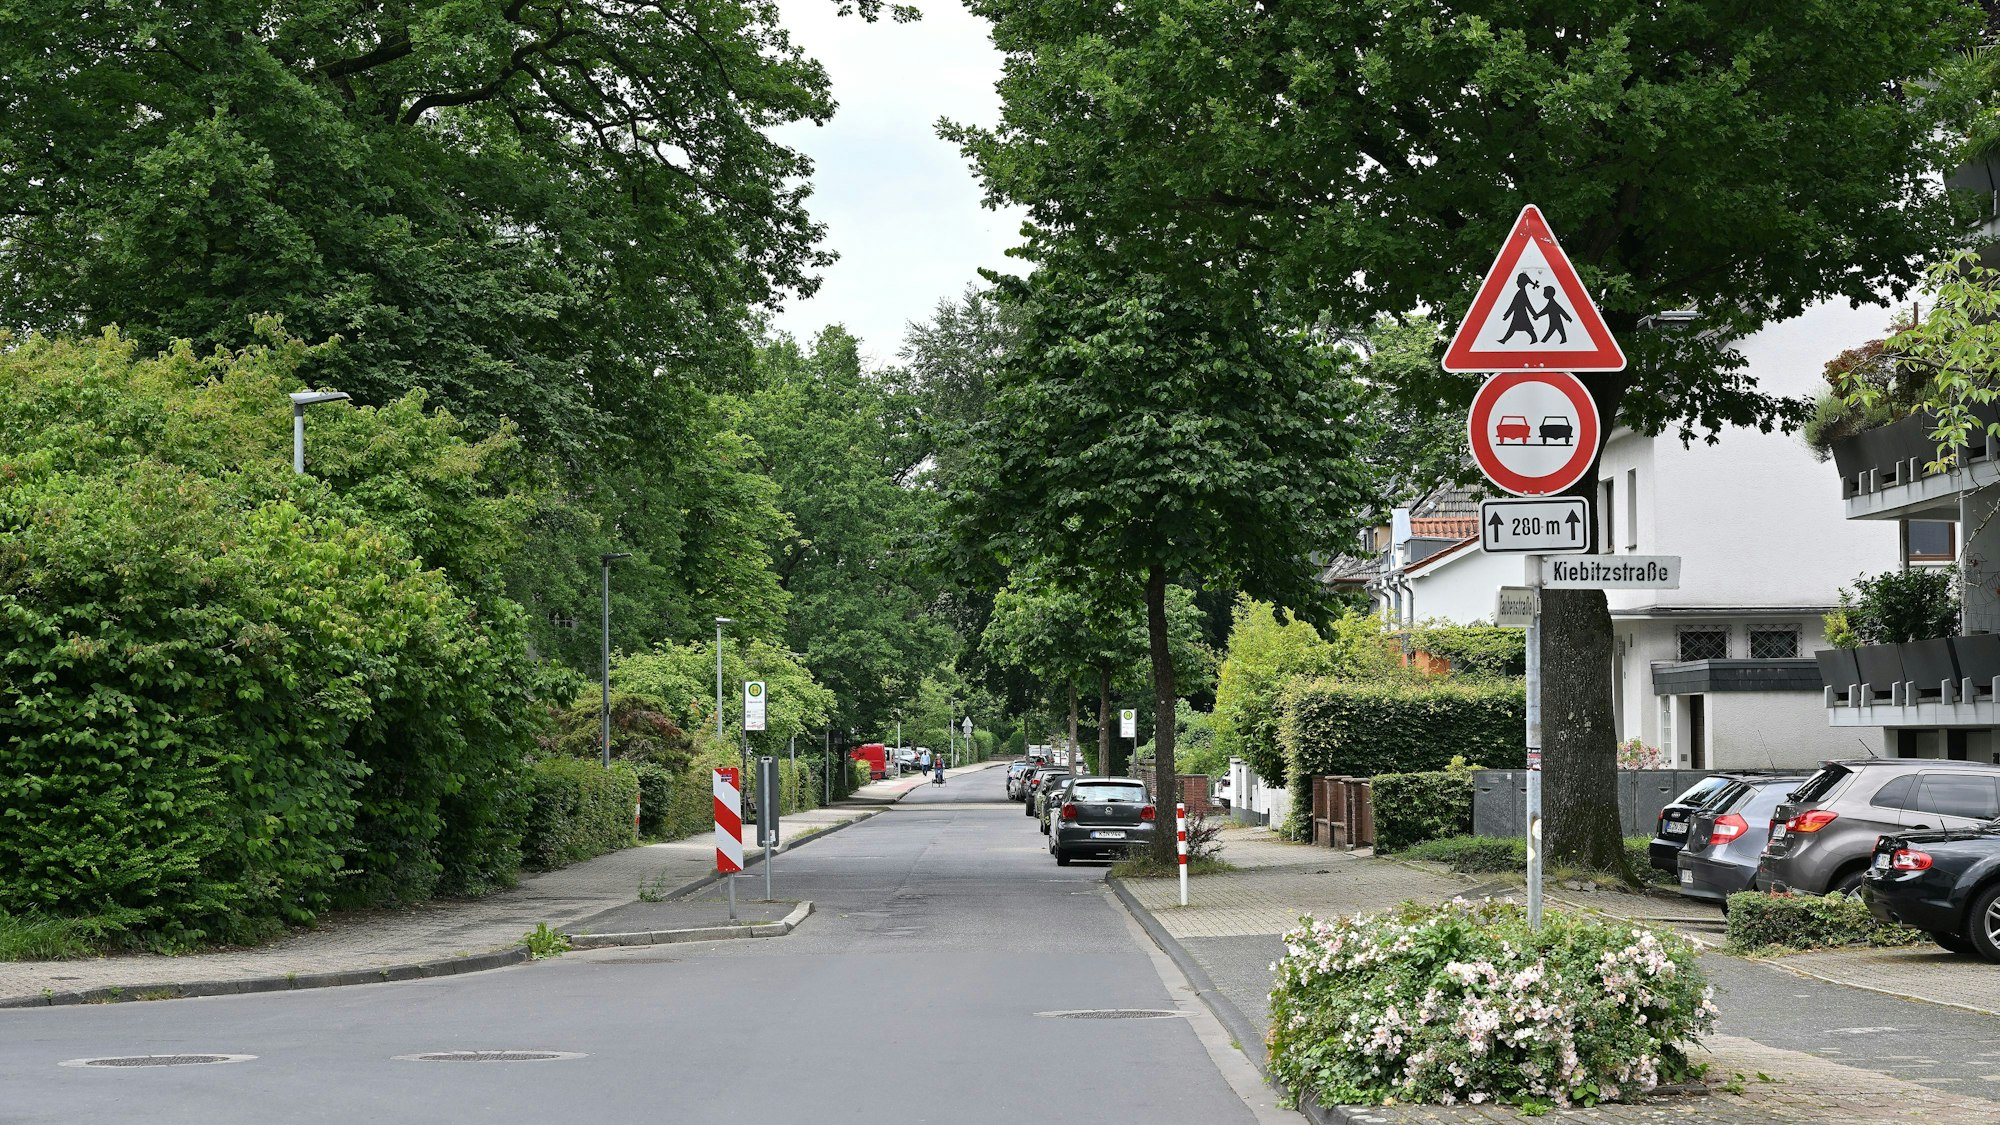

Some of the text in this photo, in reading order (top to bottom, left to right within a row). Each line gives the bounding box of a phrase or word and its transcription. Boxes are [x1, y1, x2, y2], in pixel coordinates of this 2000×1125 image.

[1513, 517, 1561, 536] 280 m
[1554, 561, 1668, 581] Kiebitzstraße
